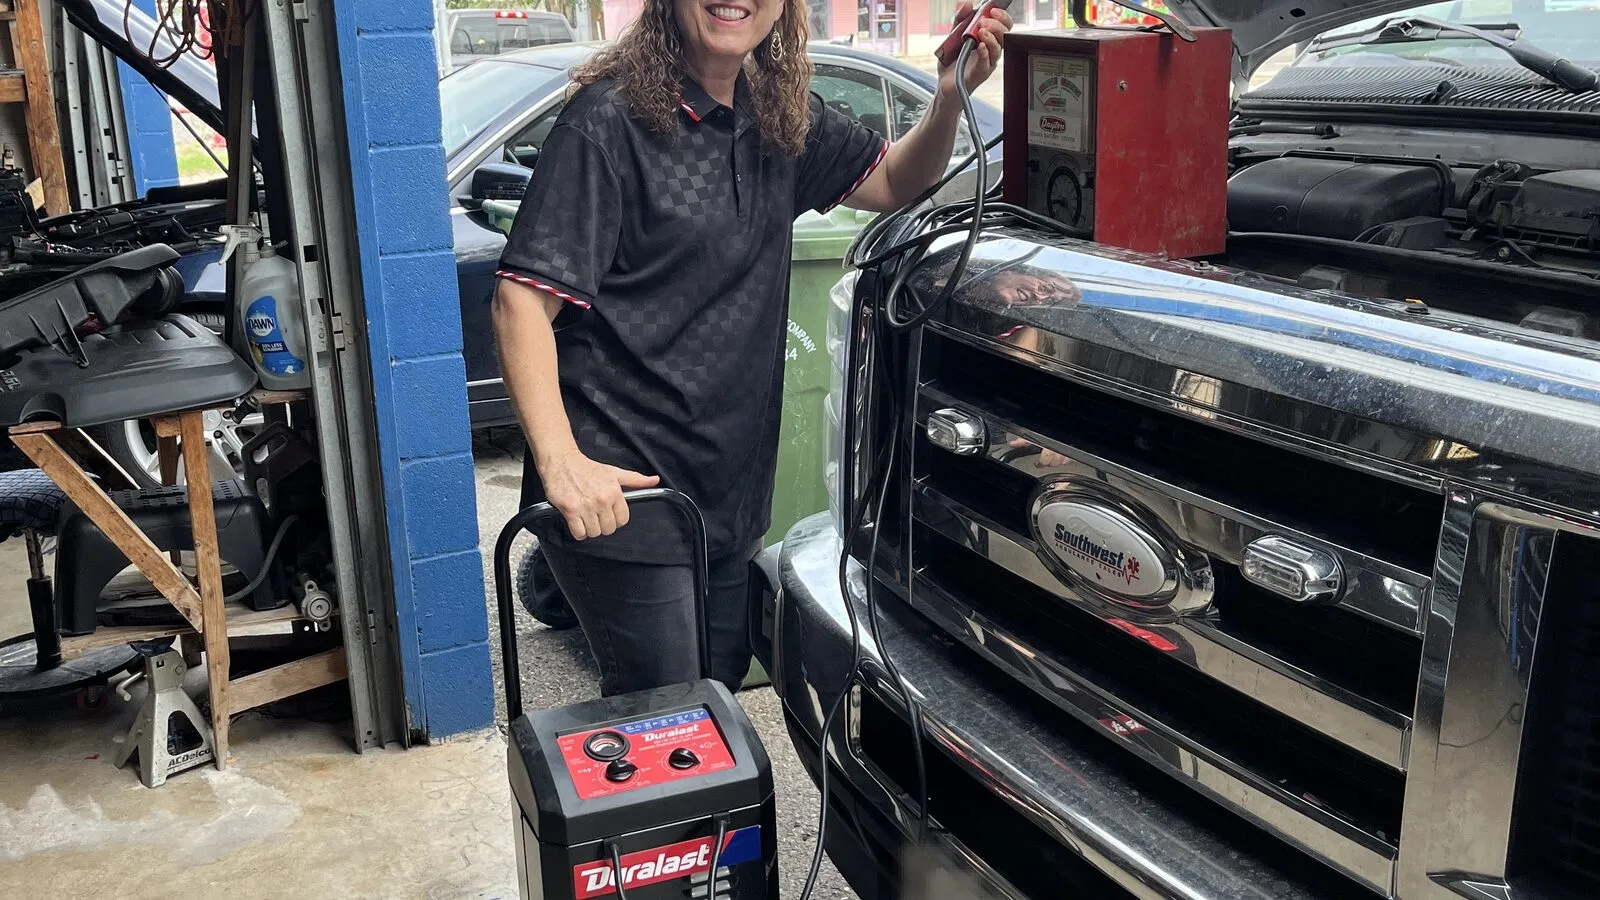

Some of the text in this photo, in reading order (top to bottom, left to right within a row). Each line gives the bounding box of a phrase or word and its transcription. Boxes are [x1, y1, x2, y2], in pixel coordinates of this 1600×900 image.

[1041, 118, 1065, 132] Dayton
[248, 317, 276, 330] DAWN
[1054, 523, 1124, 569] Southwest
[1055, 542, 1121, 578] AMBULANCE SALES
[641, 723, 700, 742] Duralast
[168, 749, 211, 767] ACDelco
